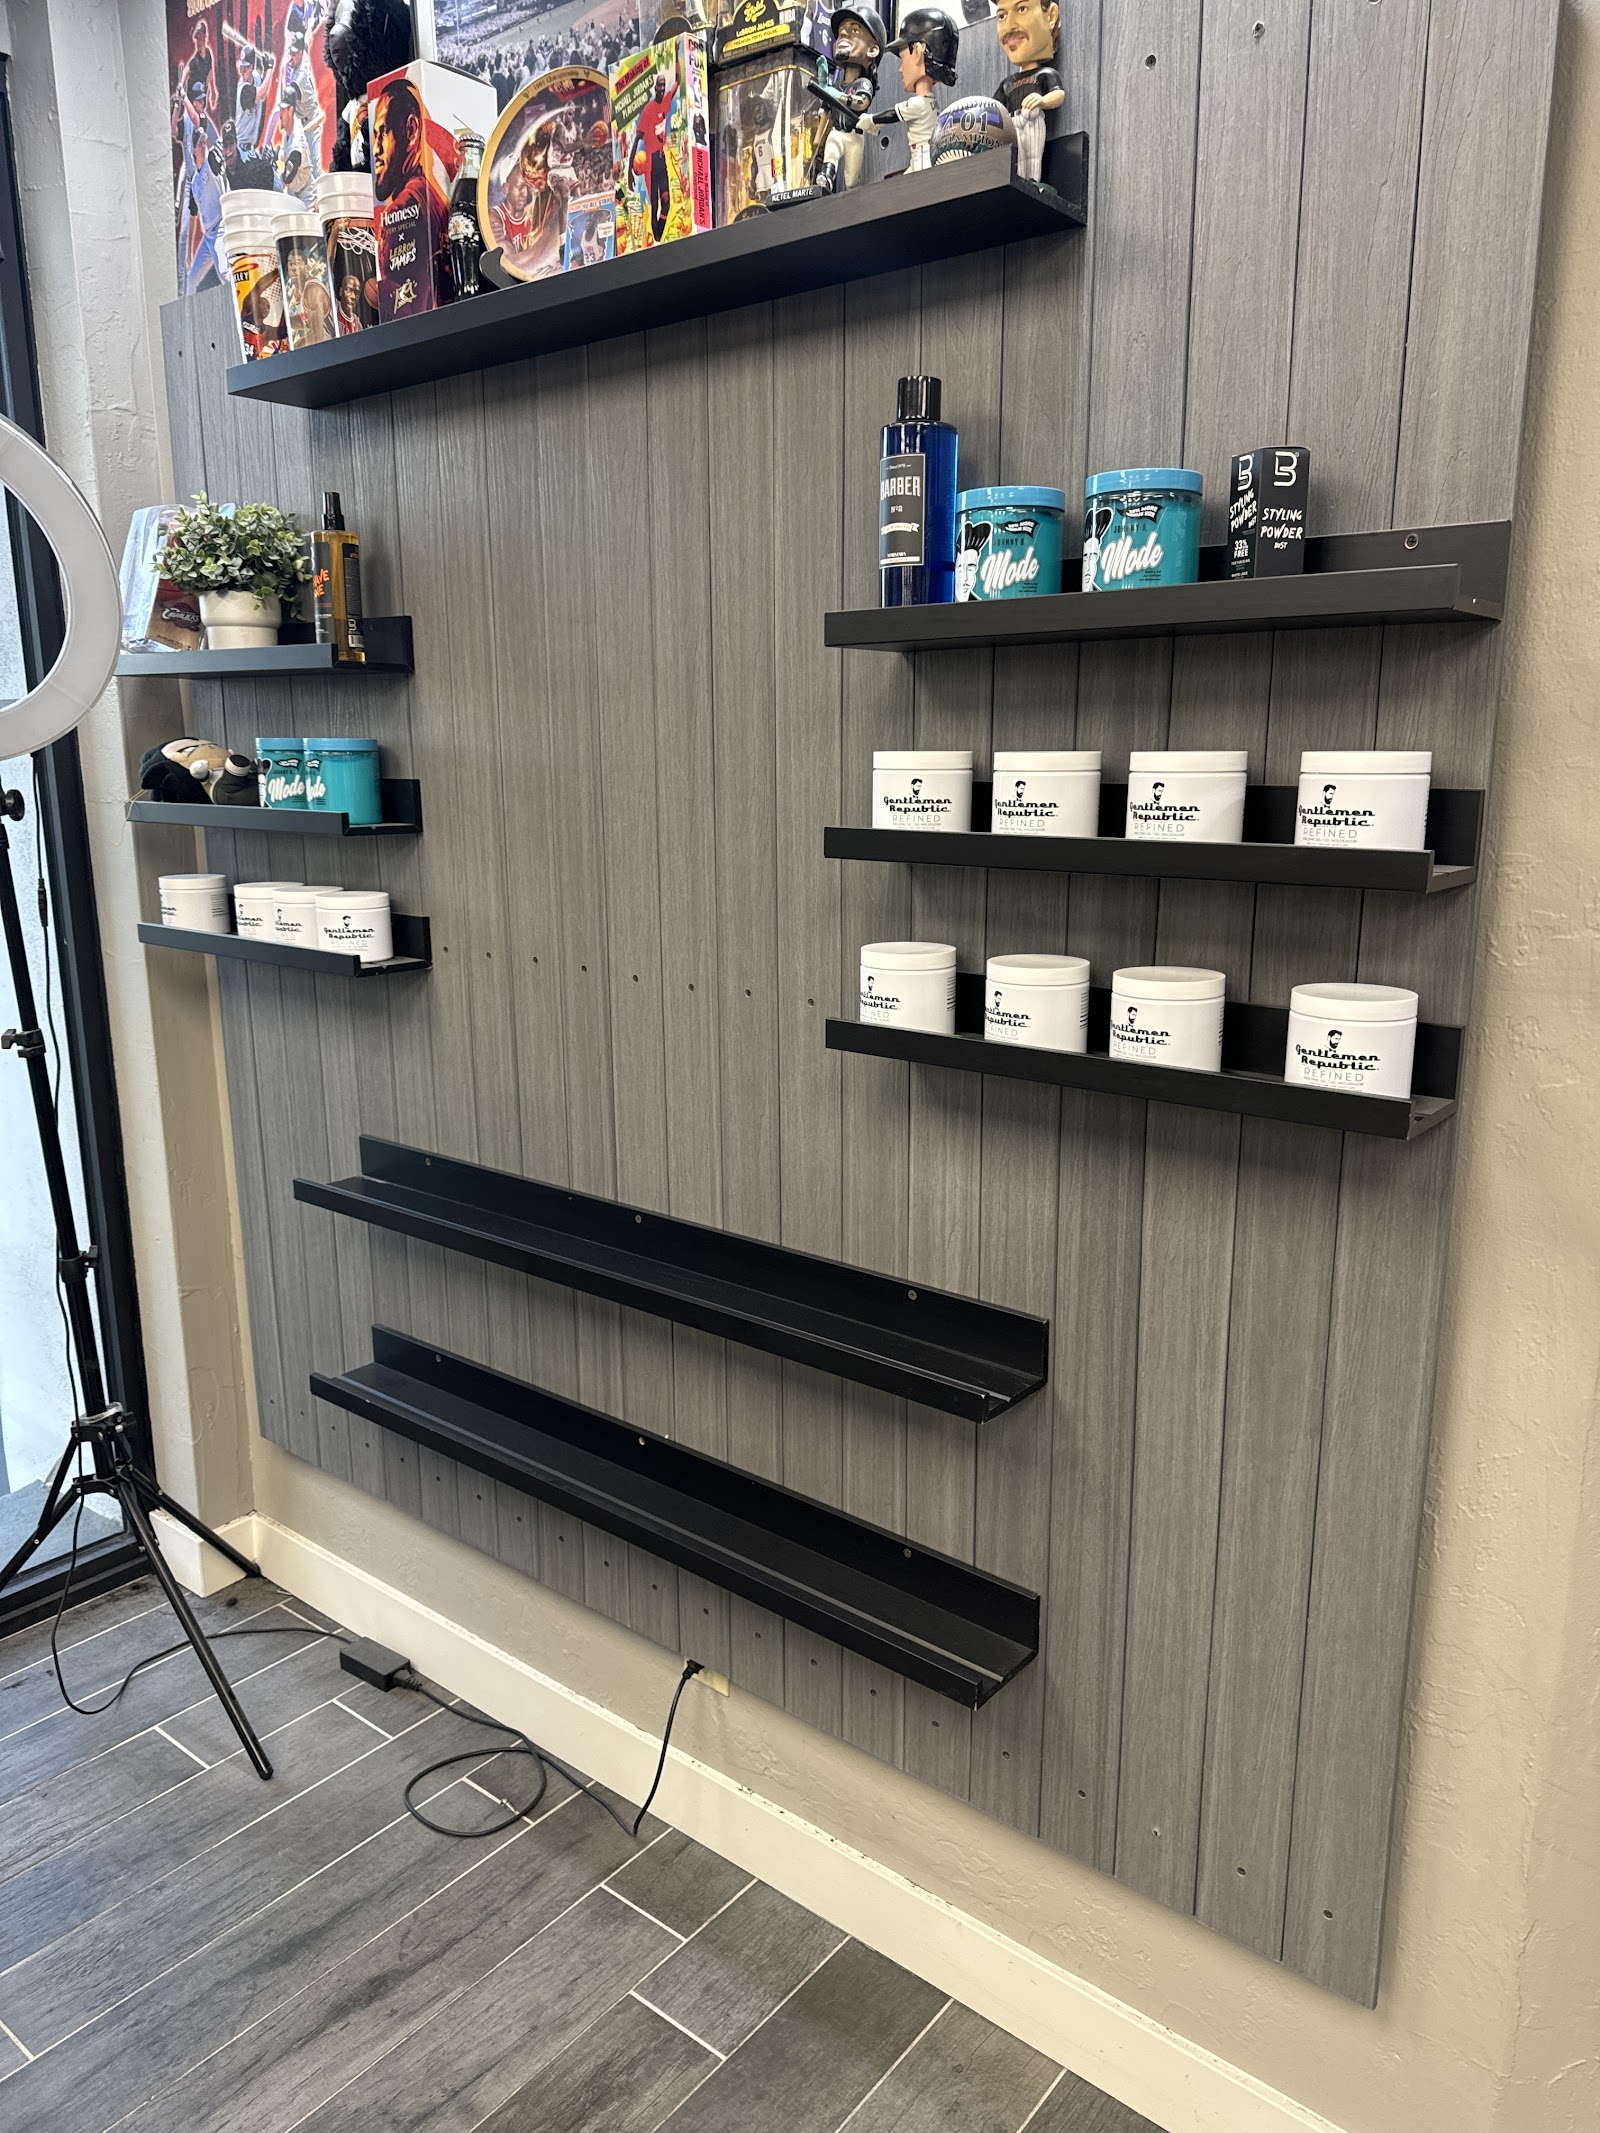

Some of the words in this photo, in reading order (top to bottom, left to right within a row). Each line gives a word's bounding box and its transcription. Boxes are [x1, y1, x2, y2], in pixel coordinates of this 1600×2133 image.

[757, 19, 775, 31] JAMES
[772, 192, 791, 202] KETEL
[792, 188, 813, 199] MARTE
[380, 204, 420, 228] Hennessy
[390, 239, 416, 260] LEBRON
[390, 250, 417, 271] JAMES
[881, 476, 921, 501] BARBER
[1230, 489, 1255, 519] STYLING
[1231, 500, 1257, 533] POWDER
[1262, 508, 1303, 523] STYLING
[1260, 523, 1303, 541] POWDER
[1274, 541, 1288, 550] DUST
[1101, 532, 1164, 585] Mode
[1234, 549, 1249, 559] FREE
[981, 546, 1040, 595] Mode
[268, 775, 305, 803] Mode
[884, 796, 953, 806] Gentlemen
[995, 799, 1060, 809] Gentlemen
[1130, 801, 1200, 812] Gentlemen
[890, 805, 949, 815] Republic
[998, 808, 1056, 818] Republic
[1299, 805, 1375, 817] Gentlemen
[893, 815, 941, 823] REFINED
[1000, 819, 1045, 828] REFINED
[1133, 812, 1196, 823] Republic
[1302, 816, 1371, 828] Republic
[1135, 823, 1185, 832] REFINED
[1303, 828, 1358, 839] REFINED
[1113, 1030, 1167, 1046] Republic
[1114, 1041, 1157, 1055] REFINED
[1296, 1044, 1381, 1061] Gentlemen
[1301, 1055, 1376, 1071] Republic
[1304, 1068, 1364, 1082] REFINED
